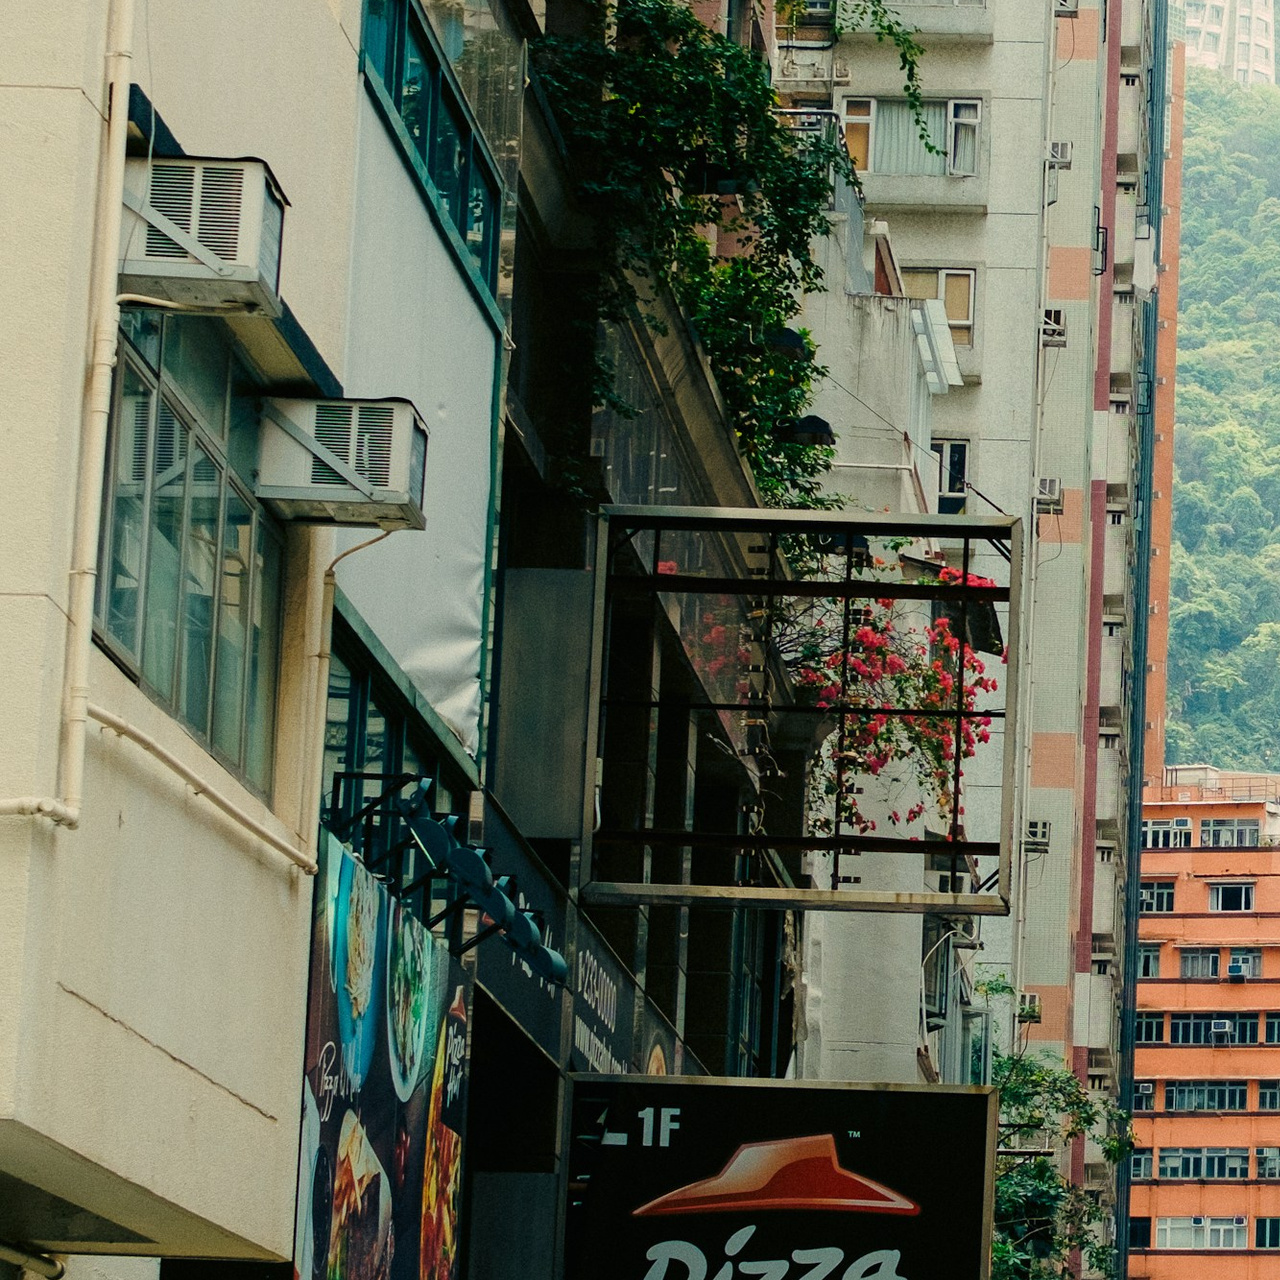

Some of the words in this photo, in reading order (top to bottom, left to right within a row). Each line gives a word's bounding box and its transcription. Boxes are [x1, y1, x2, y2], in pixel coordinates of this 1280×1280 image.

[445, 1022, 465, 1074] Pizza
[447, 1065, 463, 1108] Hut
[637, 1107, 681, 1147] 1F
